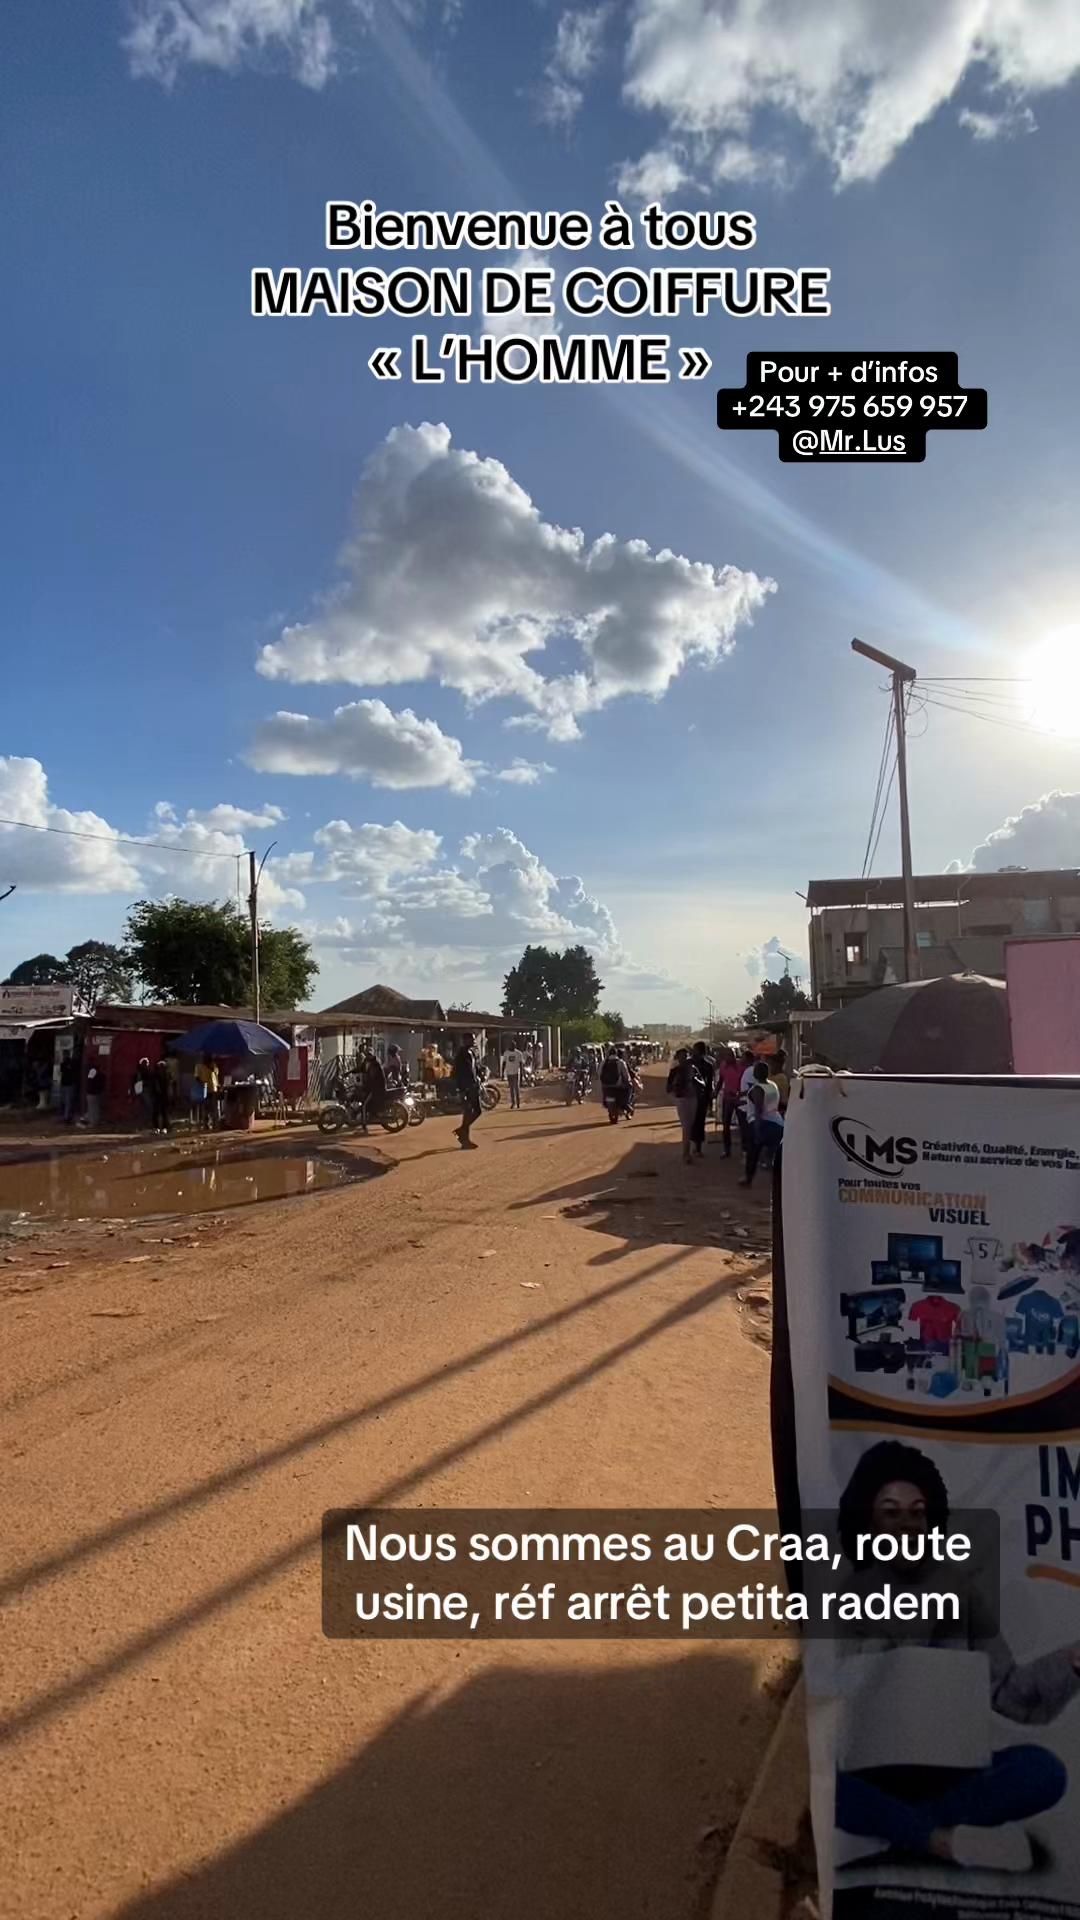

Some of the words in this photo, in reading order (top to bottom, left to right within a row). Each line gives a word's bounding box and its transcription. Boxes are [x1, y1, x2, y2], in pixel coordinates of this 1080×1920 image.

[922, 1151, 962, 1163] Nature
[963, 1154, 978, 1164] au
[980, 1155, 1023, 1167] service
[1025, 1156, 1040, 1167] de
[1042, 1159, 1063, 1169] vos
[838, 1178, 863, 1188] Pour
[864, 1178, 900, 1190] toutes
[900, 1181, 921, 1191] vos
[838, 1188, 987, 1210] COMMUNICATION
[929, 1207, 991, 1226] VISUEL
